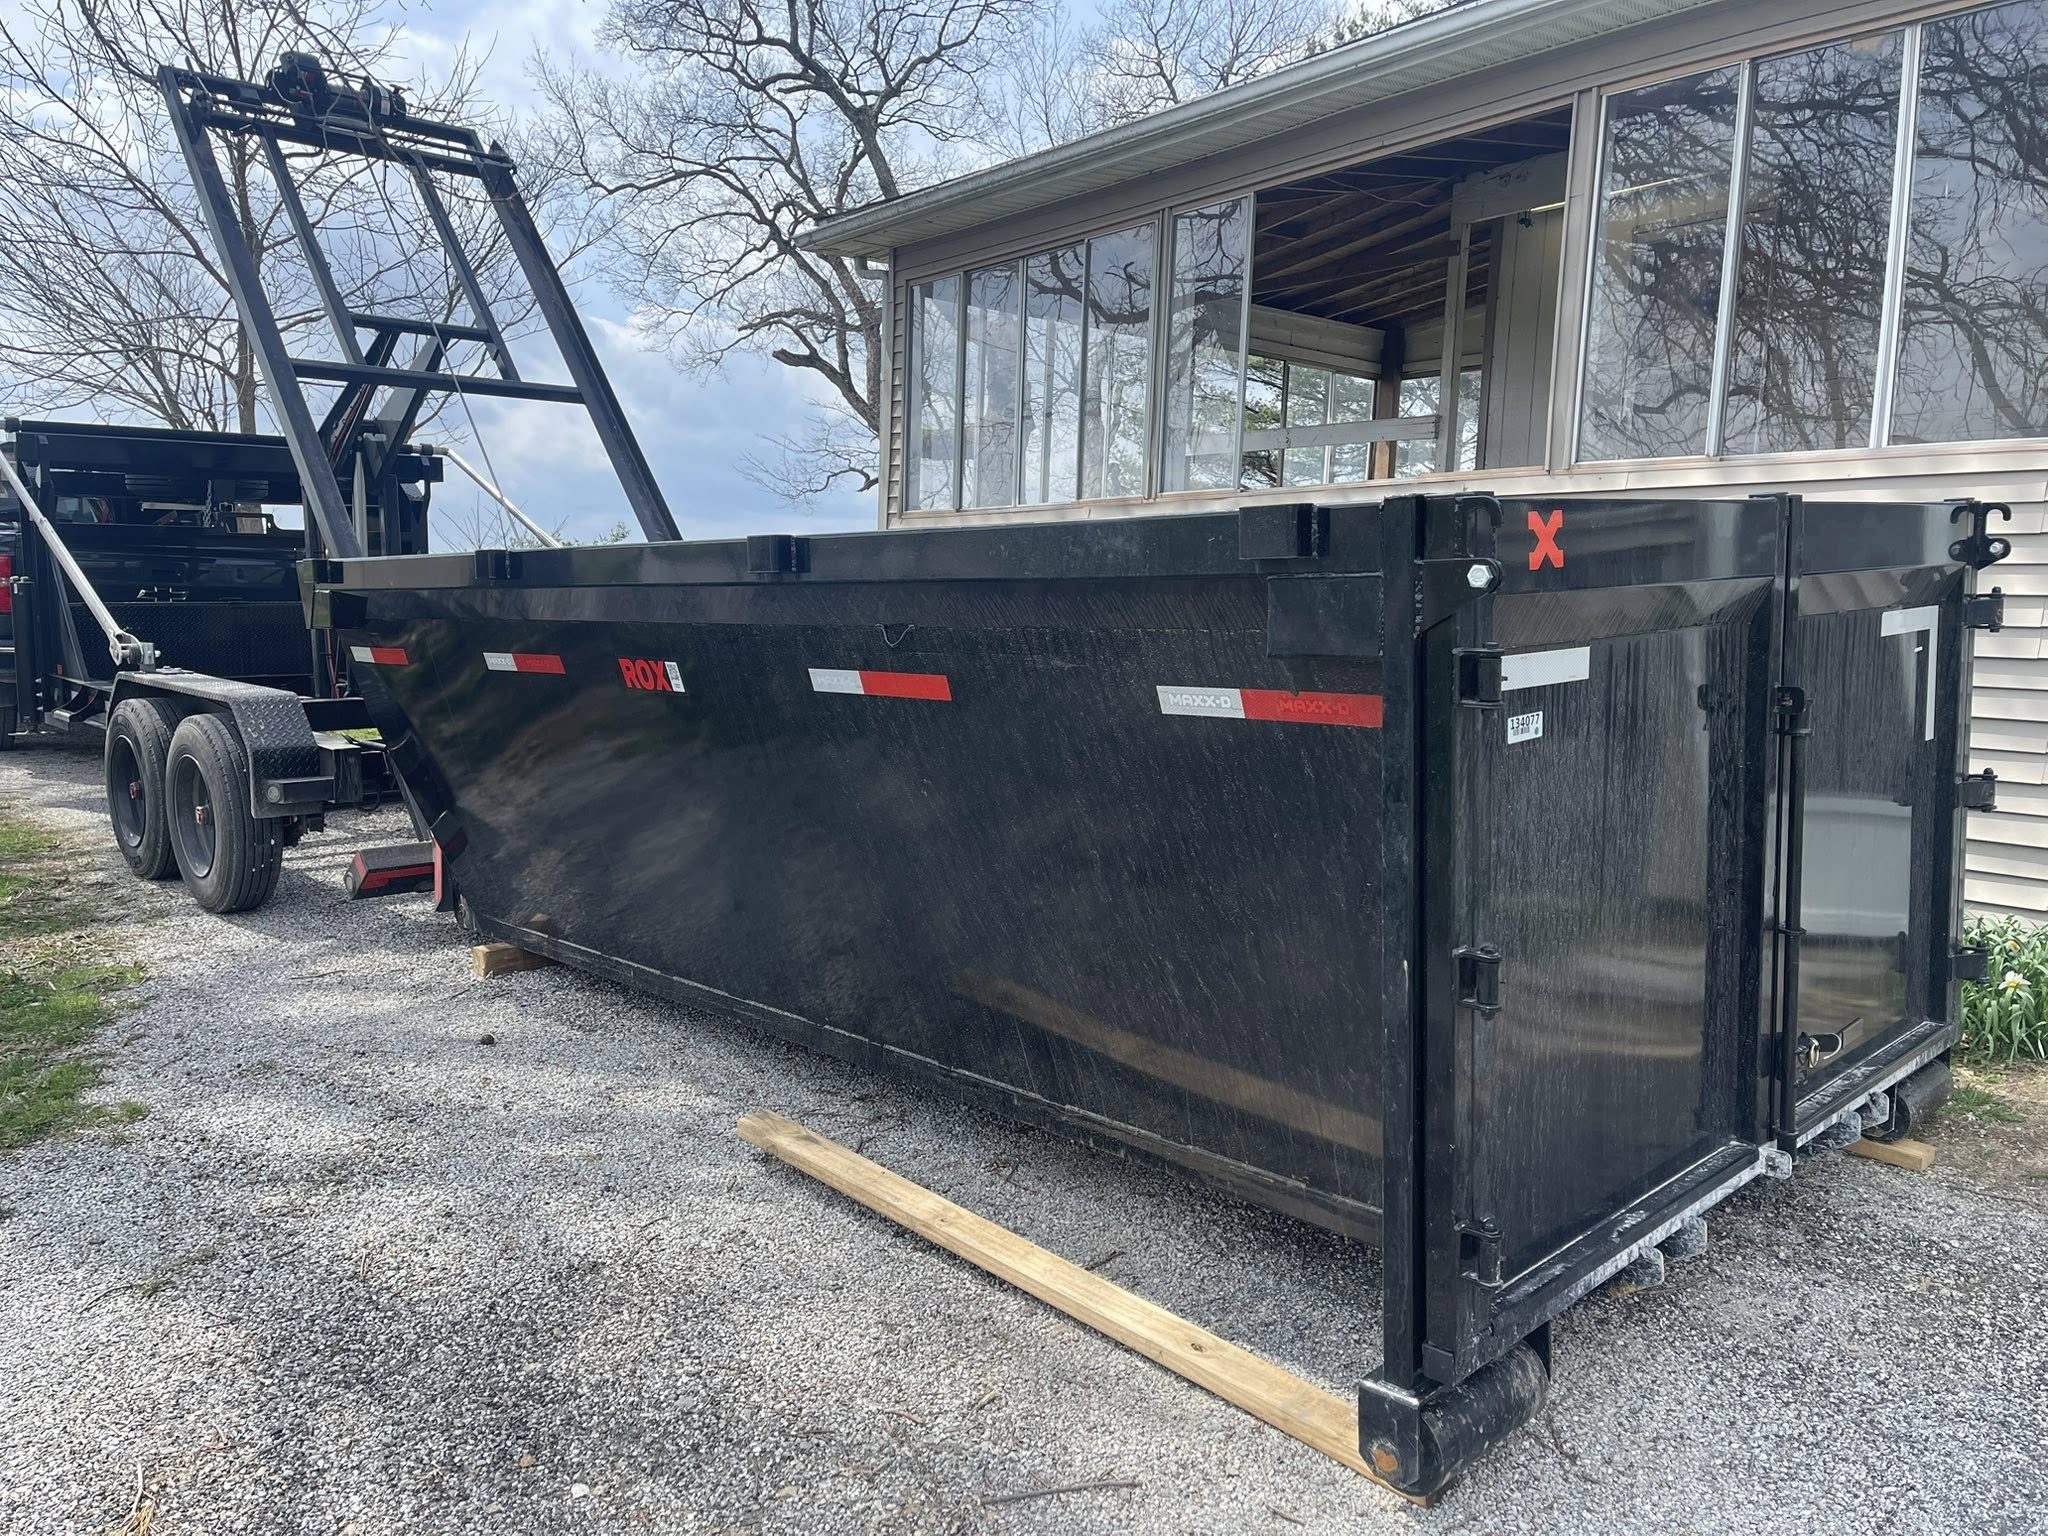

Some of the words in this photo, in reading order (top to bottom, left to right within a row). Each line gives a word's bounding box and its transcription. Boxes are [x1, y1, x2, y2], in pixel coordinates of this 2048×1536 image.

[1527, 509, 1564, 571] X
[618, 658, 673, 692] ROX
[1168, 693, 1232, 708] MAXX-D
[1278, 698, 1350, 715] MAXX-D
[1510, 713, 1540, 730] 134077
